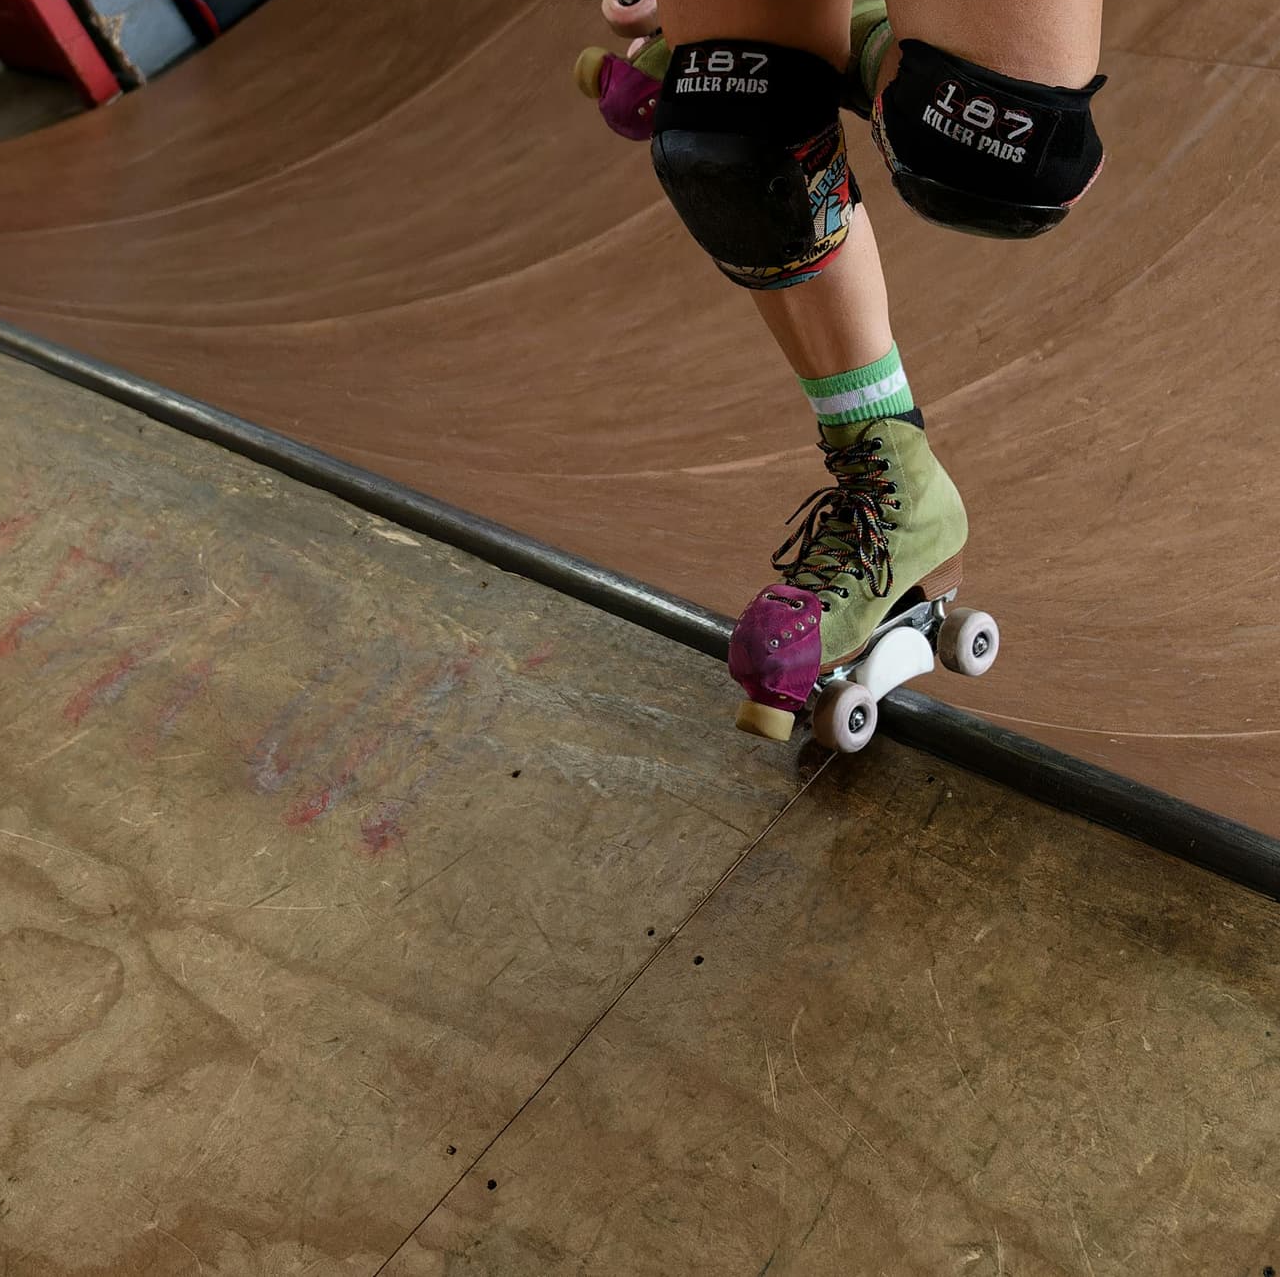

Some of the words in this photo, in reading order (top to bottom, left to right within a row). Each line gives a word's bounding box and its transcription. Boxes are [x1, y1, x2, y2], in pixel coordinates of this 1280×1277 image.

[683, 50, 768, 75] 187
[675, 76, 722, 94] KILLER
[725, 77, 768, 94] PADS
[936, 83, 1034, 140] 187
[922, 104, 975, 147] KILLER
[976, 134, 1026, 163] PADS
